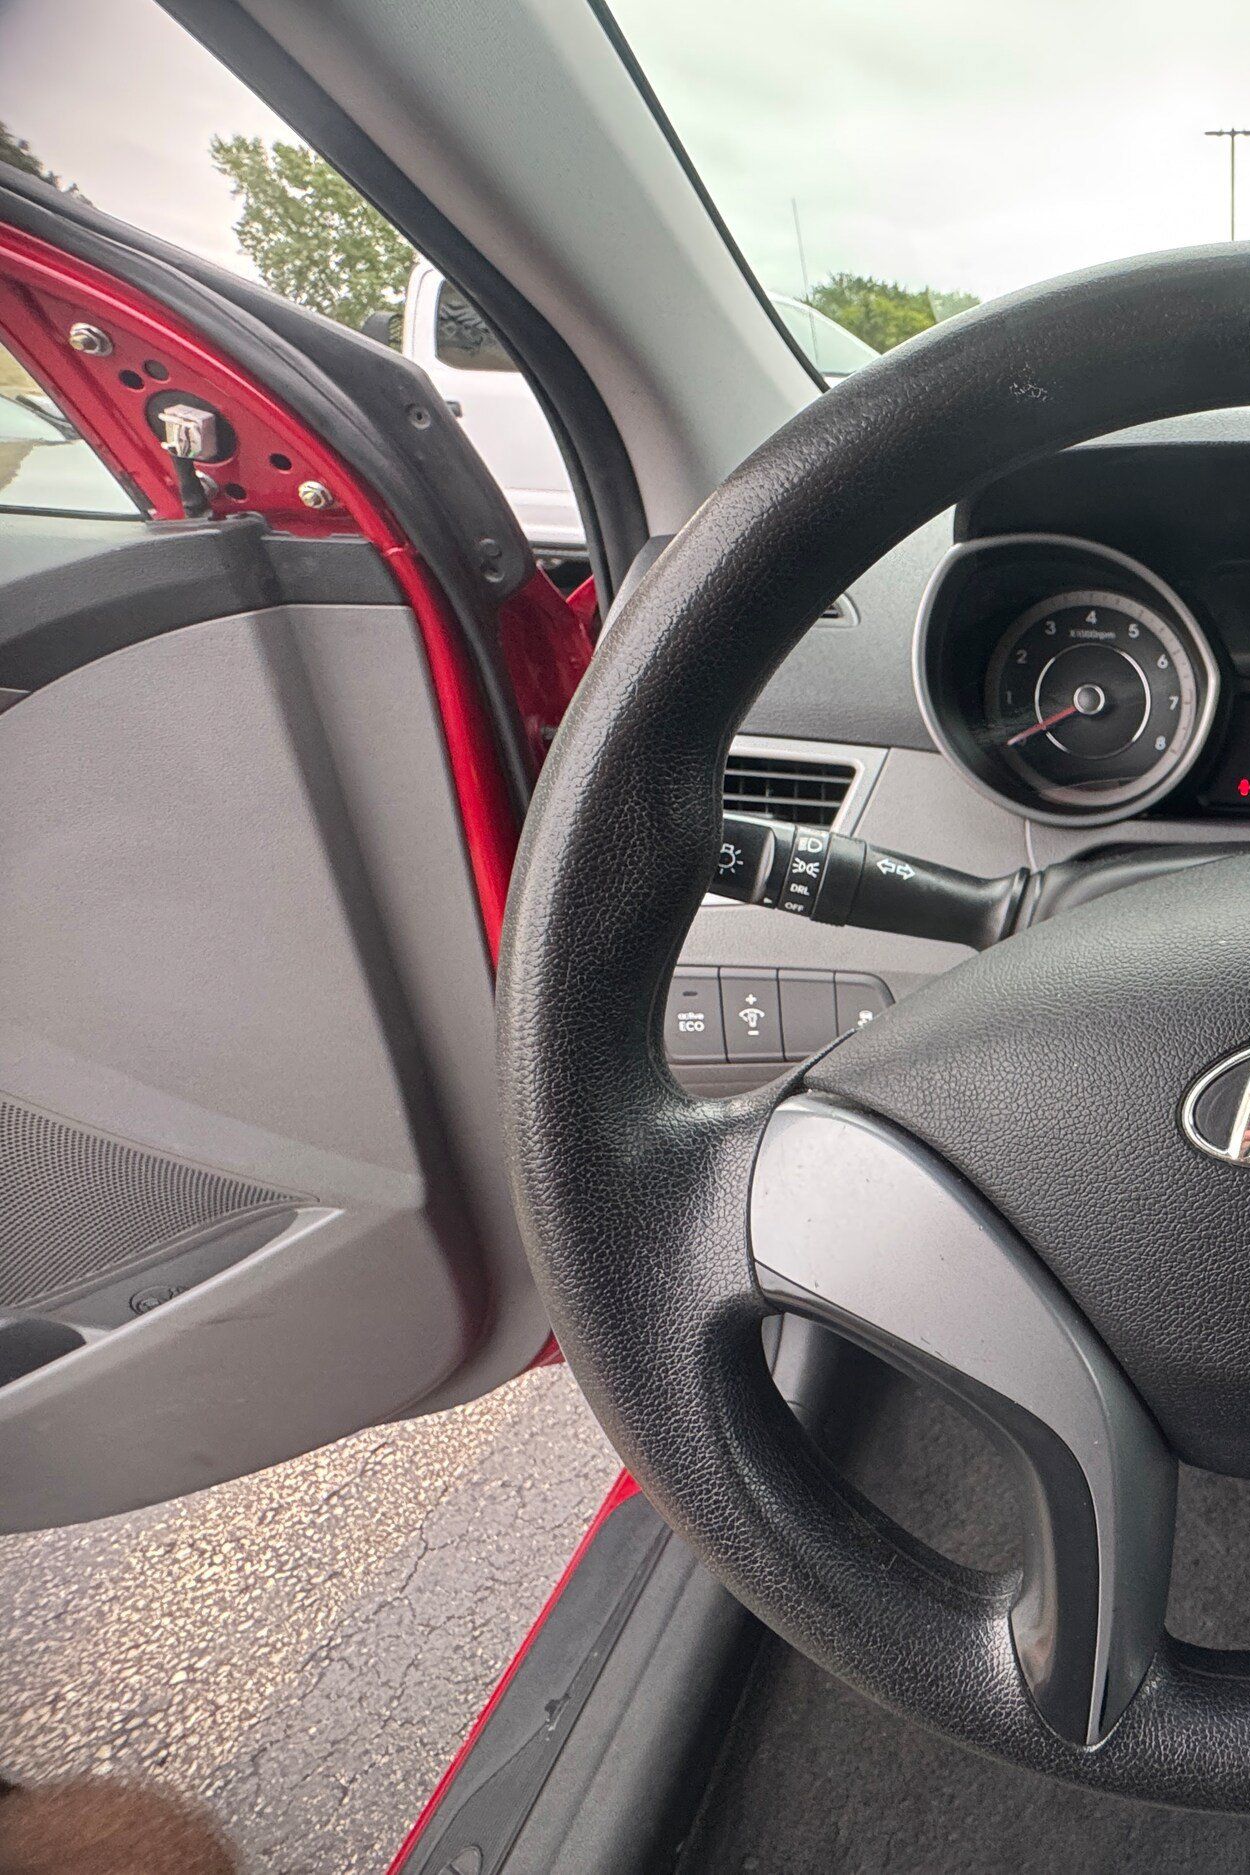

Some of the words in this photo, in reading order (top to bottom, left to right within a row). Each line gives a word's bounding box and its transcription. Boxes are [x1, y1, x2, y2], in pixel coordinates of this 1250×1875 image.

[1085, 610, 1097, 625] 4
[1045, 620, 1056, 635] 3
[1128, 623, 1140, 639] 5
[1017, 650, 1027, 664] 2
[1157, 654, 1169, 669] 6
[1006, 691, 1012, 704] 1
[1169, 696, 1179, 710] 7
[1155, 735, 1166, 750] 8
[790, 883, 810, 896] DRL
[784, 902, 804, 912] OFF
[679, 1021, 704, 1032] ECO
